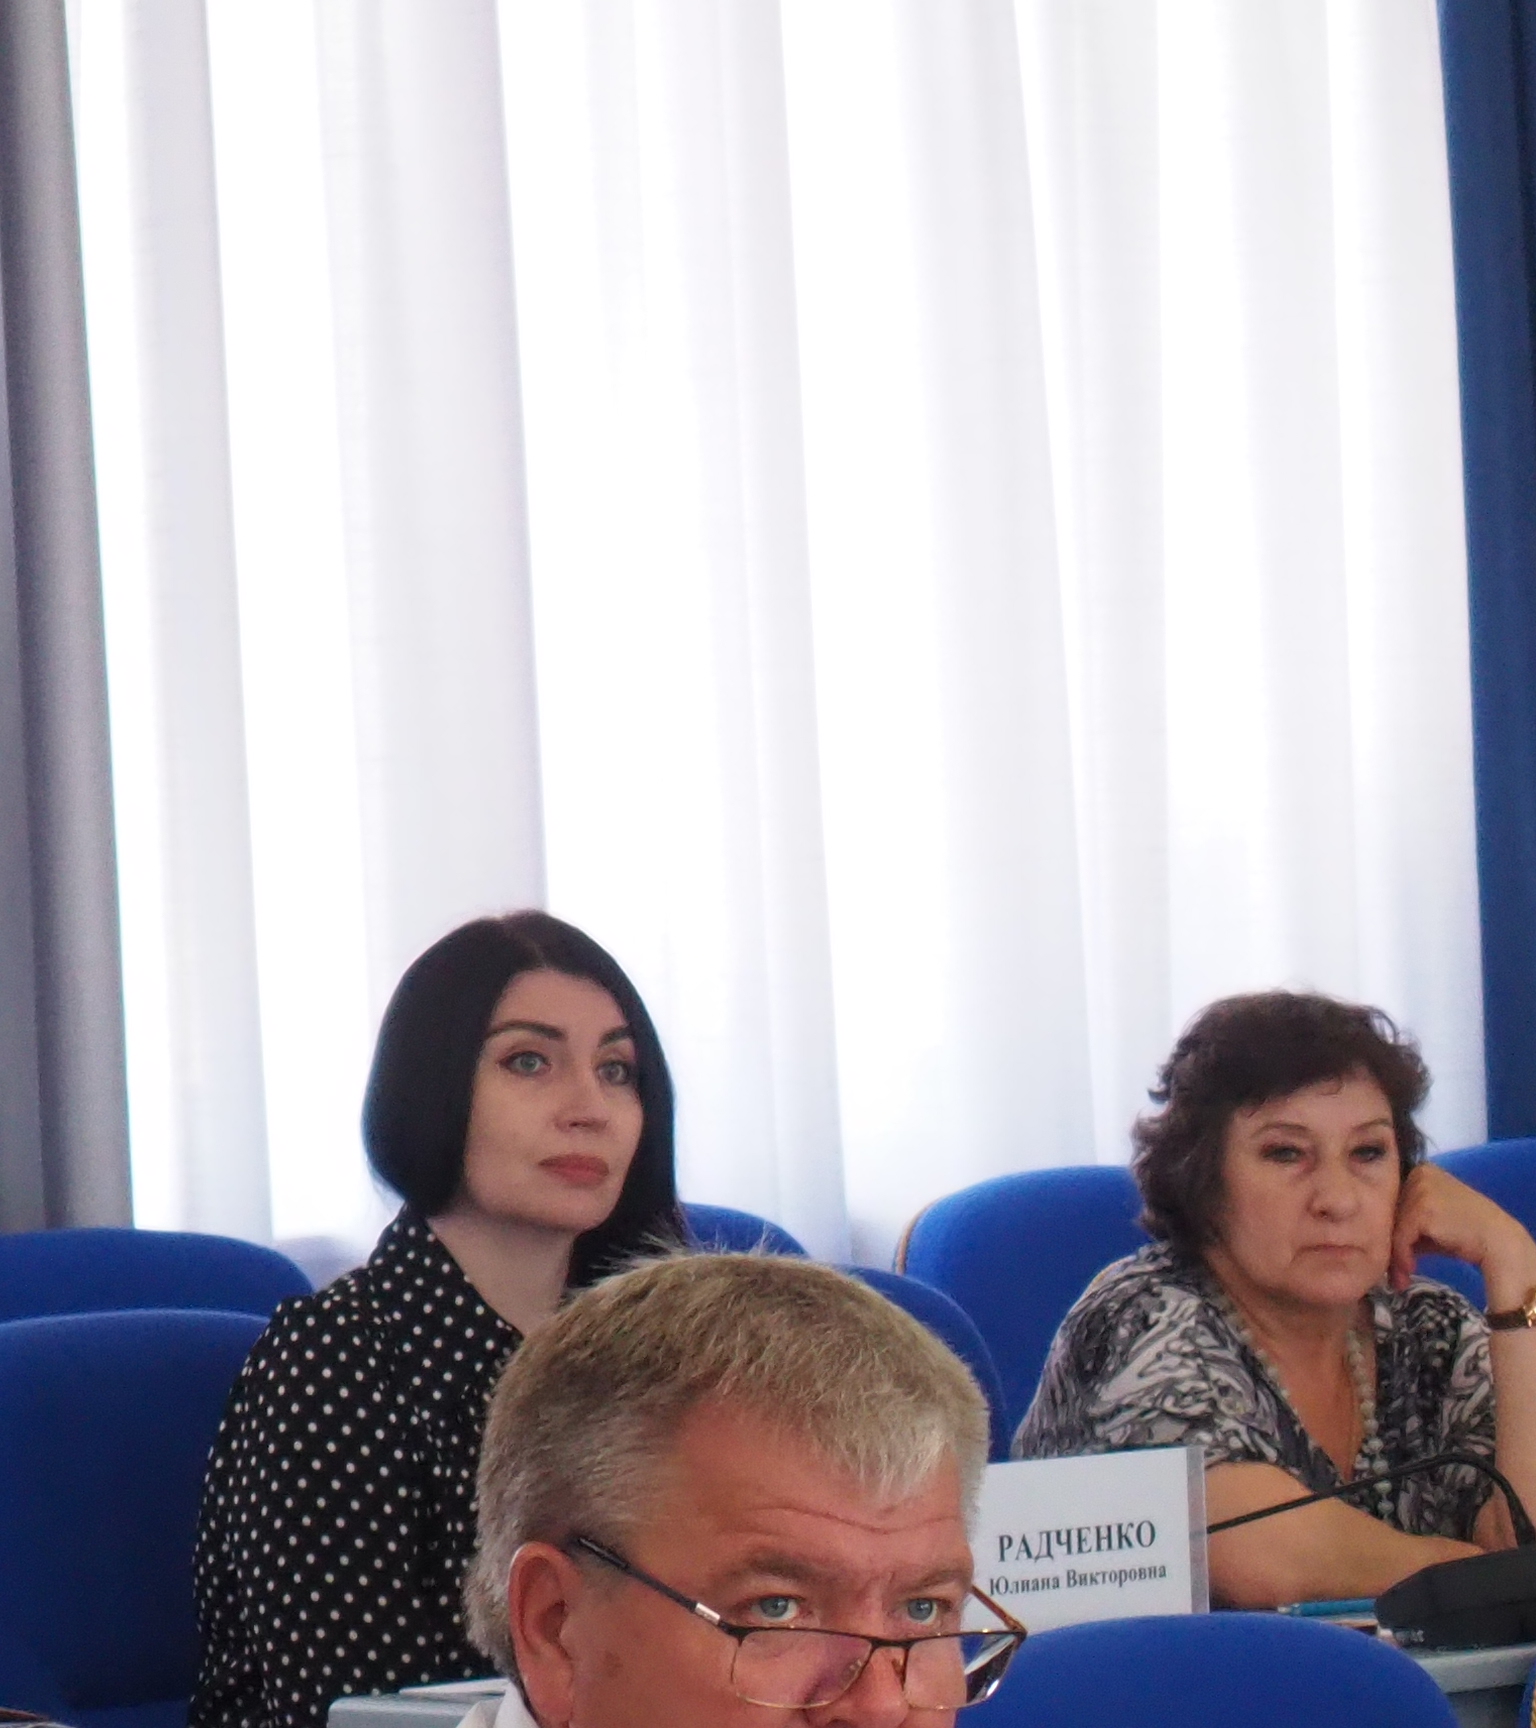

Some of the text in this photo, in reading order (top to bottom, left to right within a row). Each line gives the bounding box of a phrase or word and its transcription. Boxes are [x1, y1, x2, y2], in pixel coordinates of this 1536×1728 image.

[999, 1520, 1156, 1562] РАДЧЕНКО
[989, 1565, 1167, 1596] Юлиана Викторовна
